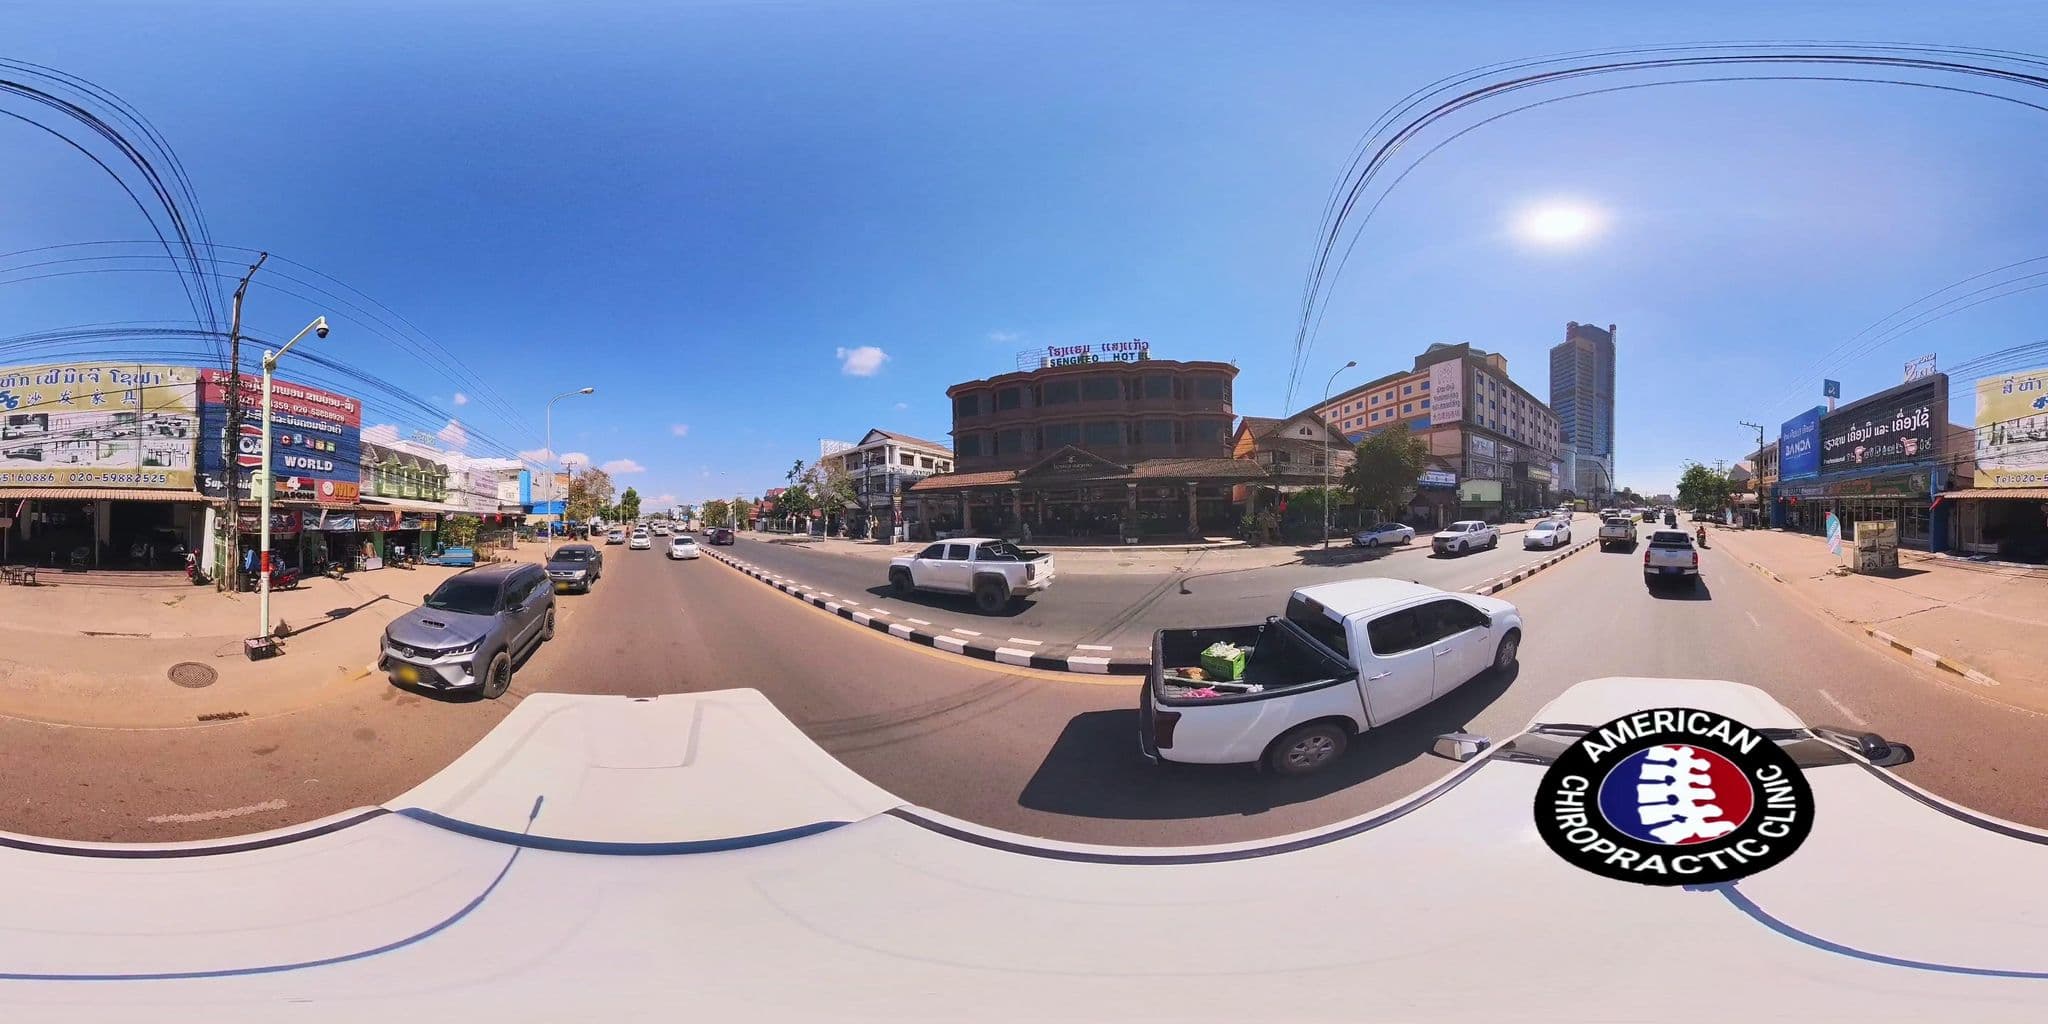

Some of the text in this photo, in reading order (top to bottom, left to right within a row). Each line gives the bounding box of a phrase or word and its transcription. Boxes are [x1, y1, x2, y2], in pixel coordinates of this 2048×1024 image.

[1050, 352, 1151, 368] SENGKEO HOTEL
[284, 456, 333, 471] WORLD
[69, 472, 166, 483] 020-59882525
